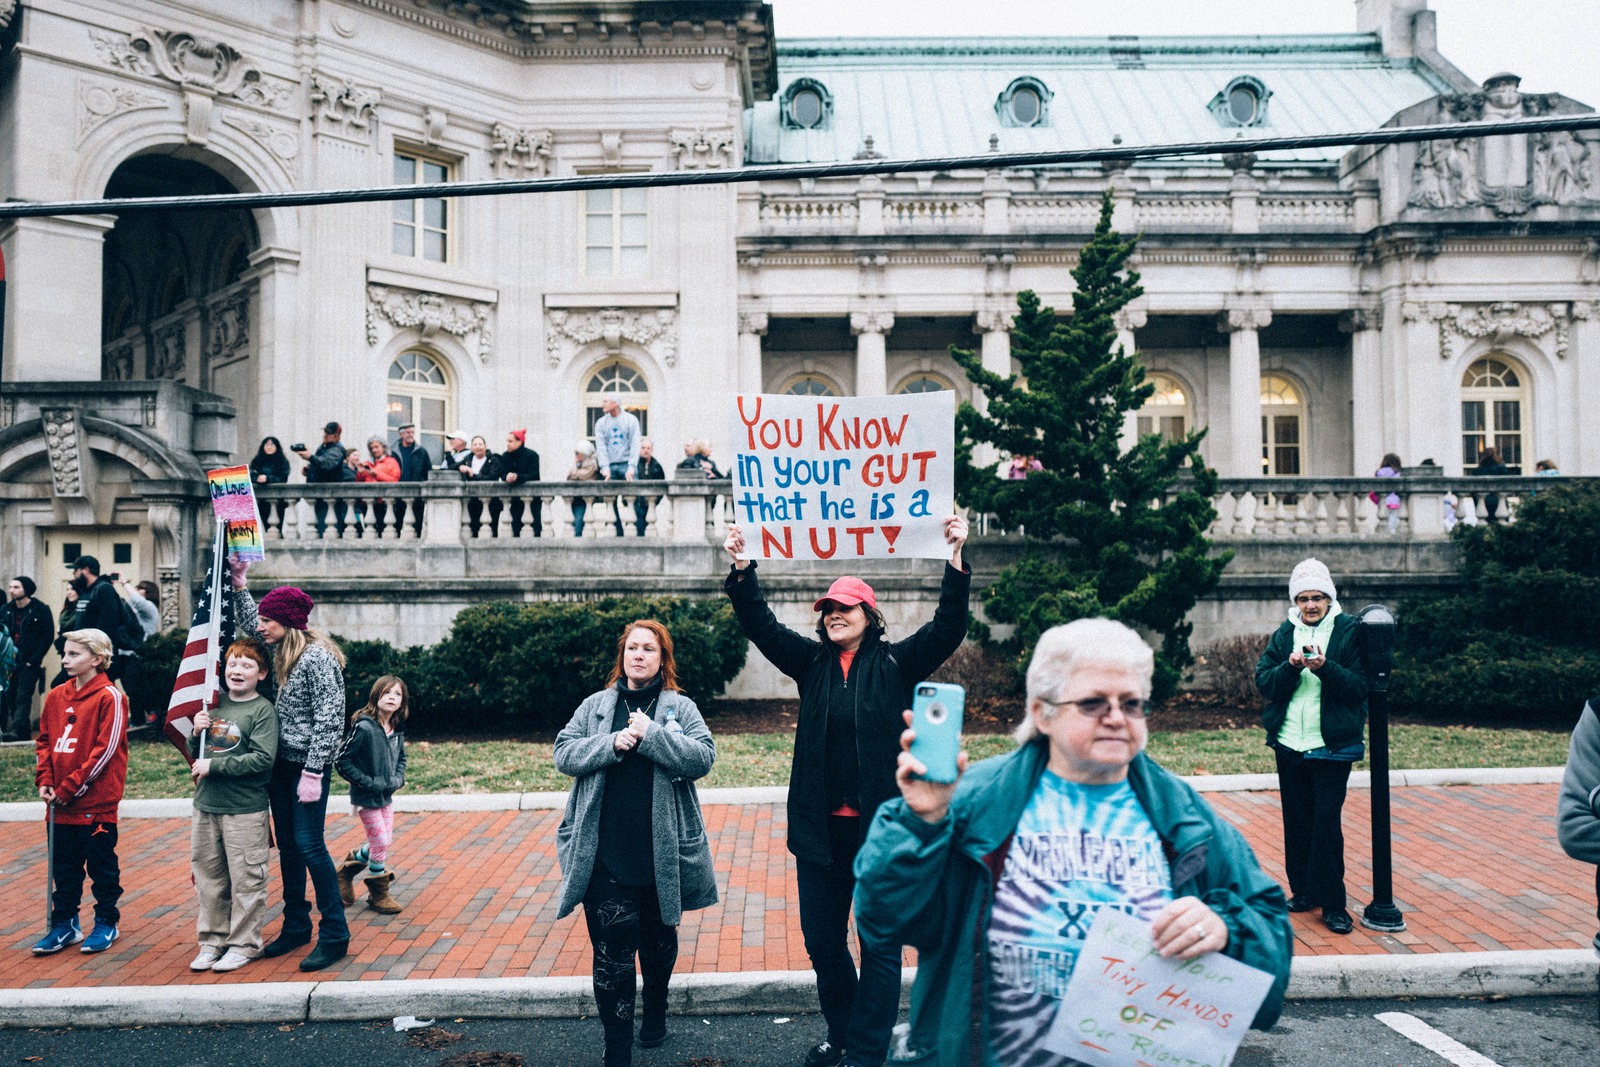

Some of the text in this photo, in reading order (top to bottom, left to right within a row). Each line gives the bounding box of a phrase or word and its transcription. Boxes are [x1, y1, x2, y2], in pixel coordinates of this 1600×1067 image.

[737, 451, 937, 489] in your GUT
[738, 489, 933, 523] that he is a
[761, 525, 902, 560] NUT!
[1120, 1004, 1176, 1031] OFF
[1155, 983, 1233, 1029] HANDS
